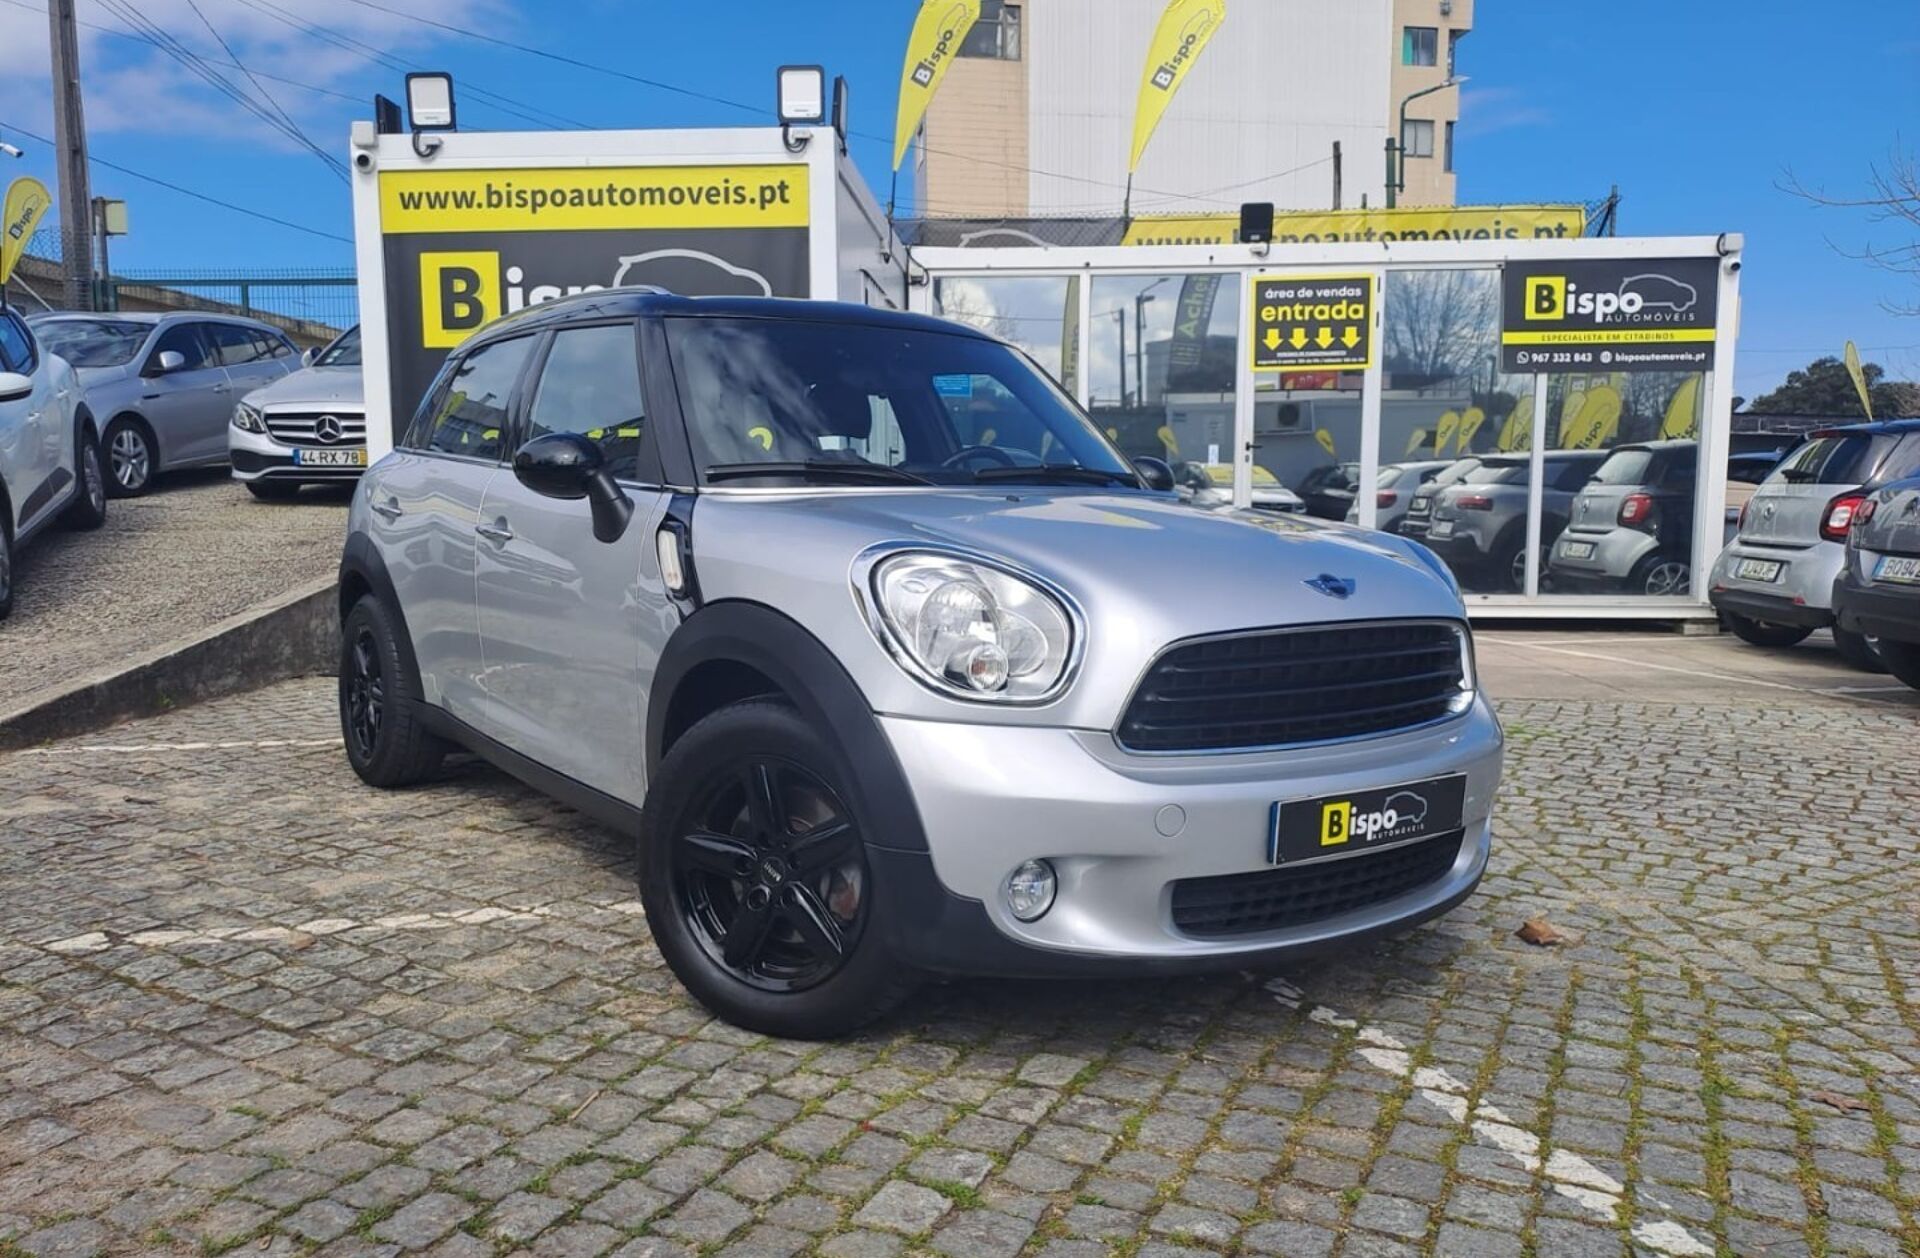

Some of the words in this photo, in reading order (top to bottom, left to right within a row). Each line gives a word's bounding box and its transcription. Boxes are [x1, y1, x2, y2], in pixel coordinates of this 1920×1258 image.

[913, 29, 954, 85] Bispo
[1153, 33, 1197, 88] Bispo
[399, 178, 790, 211] www.bispoautomoveis.pt
[1265, 288, 1295, 299] área
[1297, 287, 1313, 298] de
[1316, 286, 1362, 297] vendas
[1534, 282, 1643, 323] Bispo
[1261, 300, 1364, 322] entrada
[1604, 312, 1696, 323] AUTOMÓVEIS
[1541, 333, 1603, 342] ESPECIALISTA
[1606, 333, 1620, 341] EM
[1624, 332, 1675, 341] CITADINOS
[1531, 352, 1549, 363] 967
[1552, 352, 1571, 363] 332
[1574, 352, 1593, 362] 843
[1327, 806, 1397, 841] Bispo
